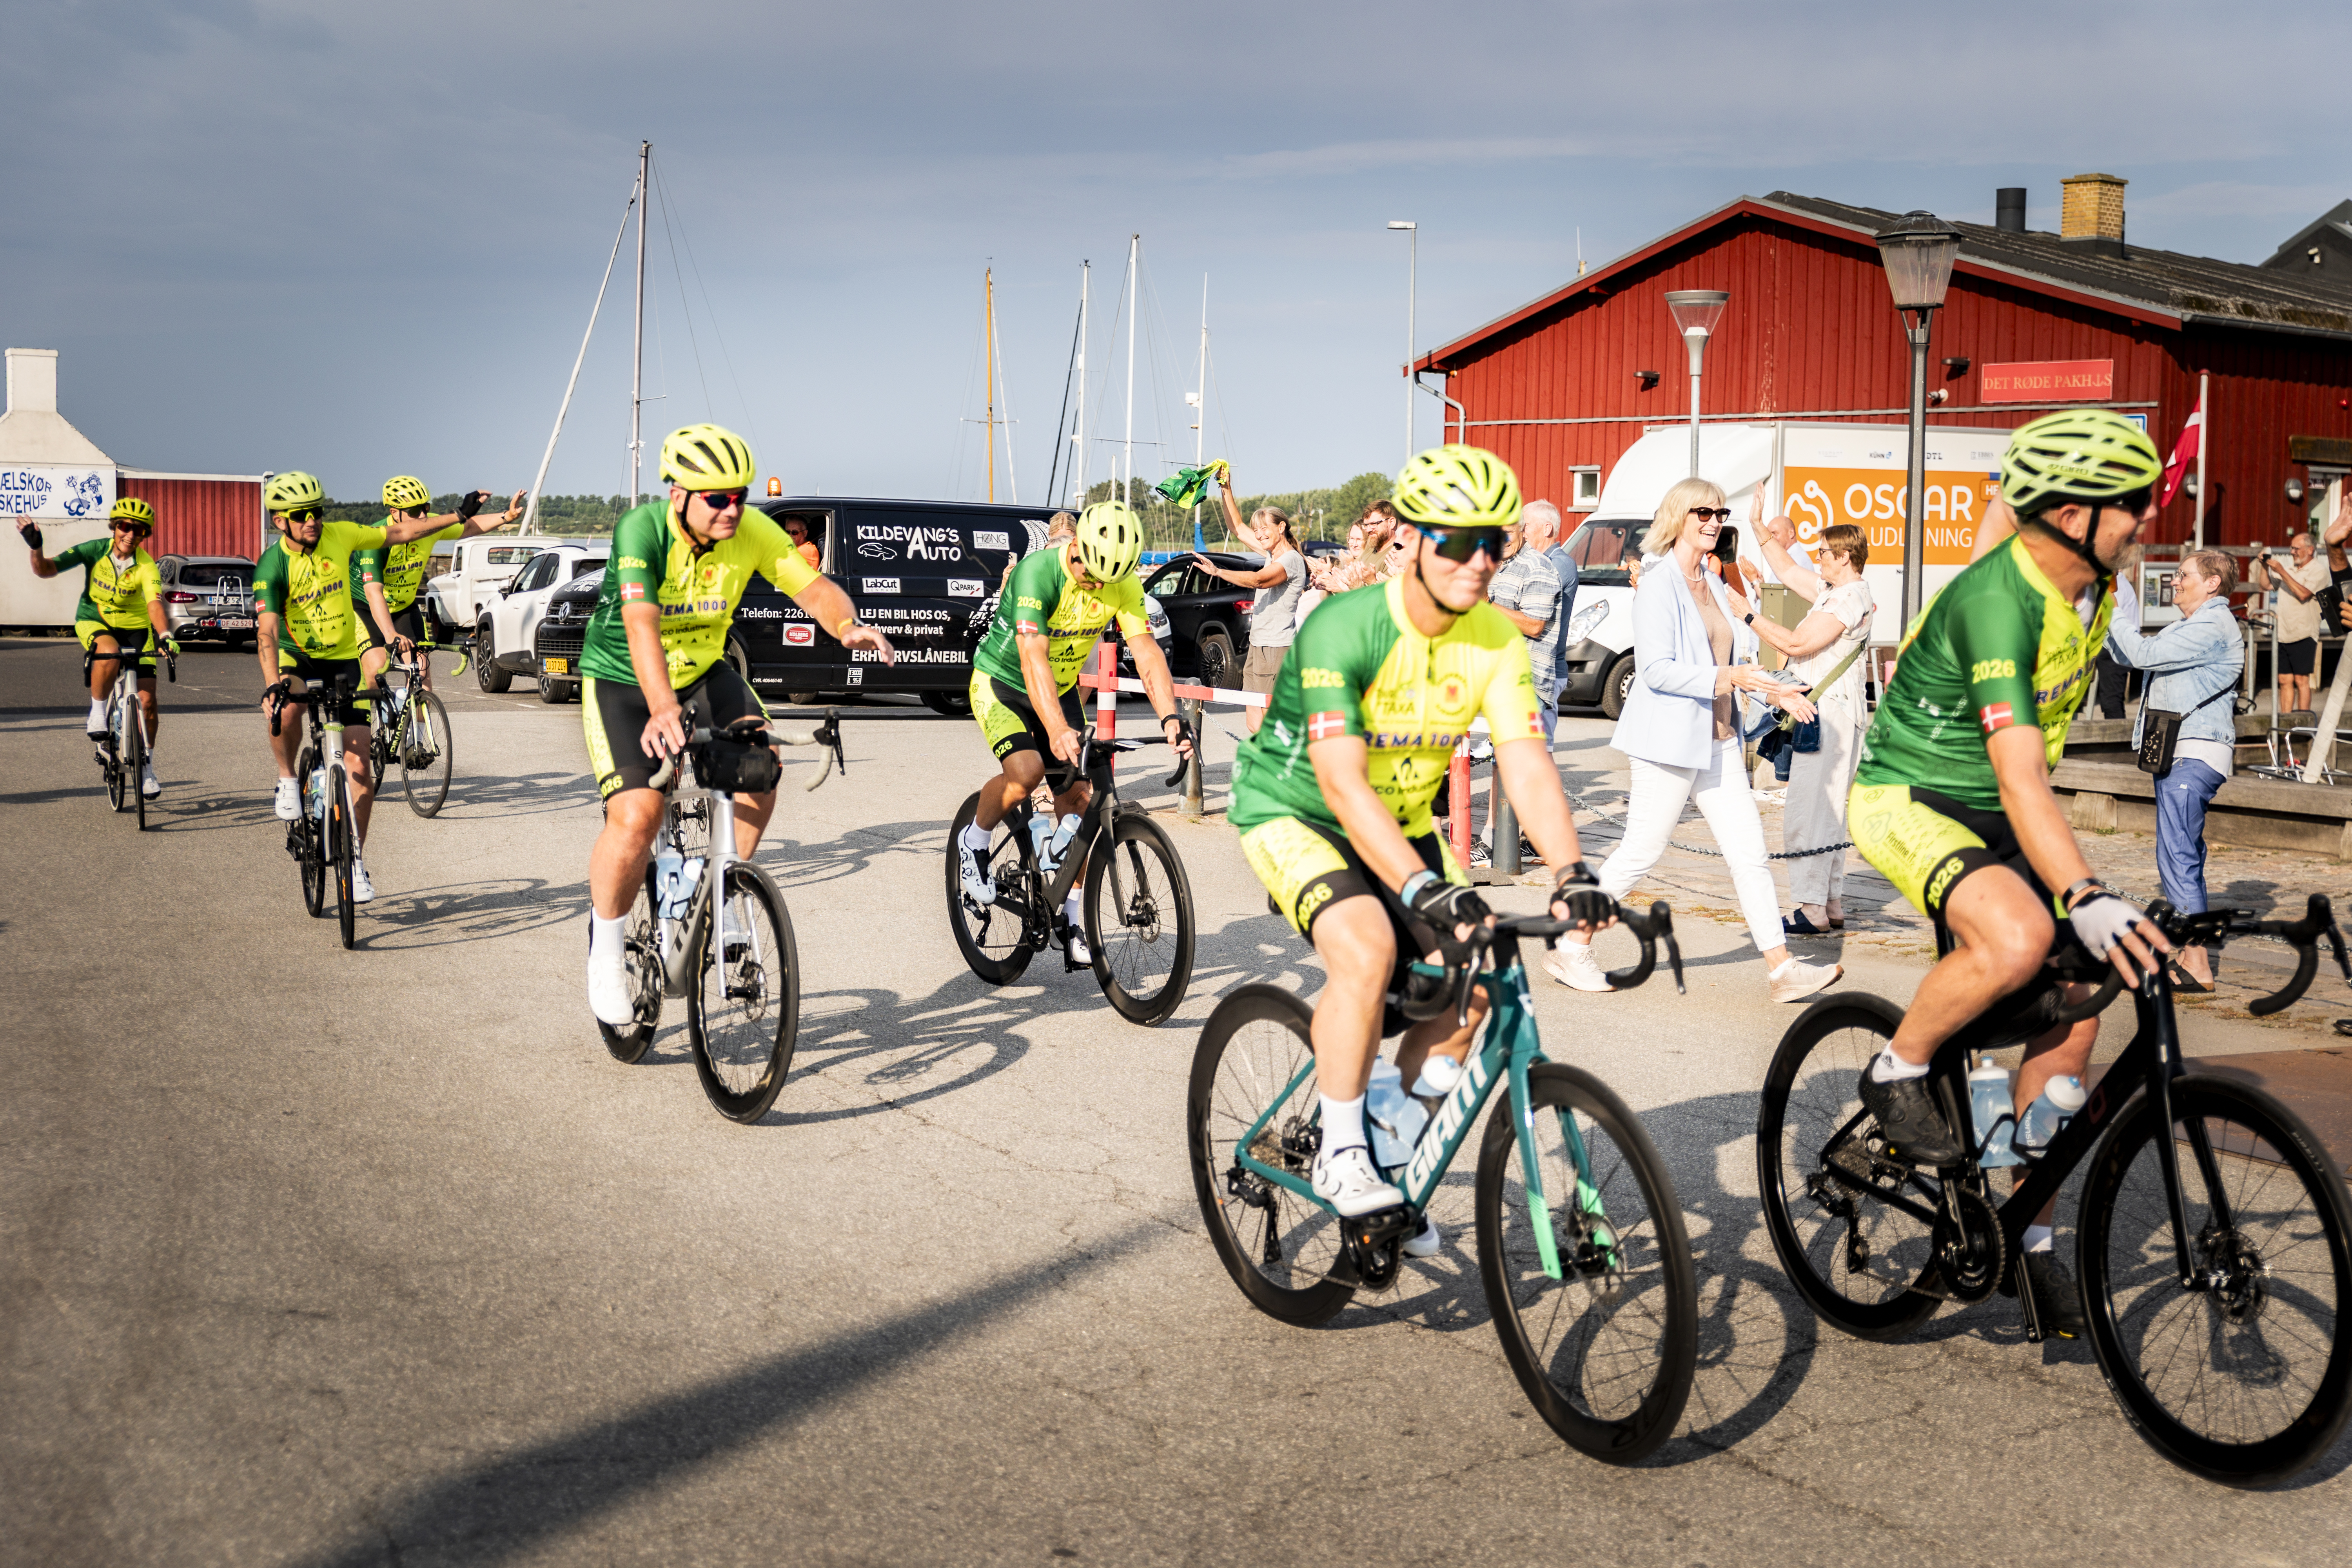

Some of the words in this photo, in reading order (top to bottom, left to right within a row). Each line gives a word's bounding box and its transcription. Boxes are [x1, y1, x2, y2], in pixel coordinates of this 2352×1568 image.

[1984, 377, 2010, 390] DET
[2013, 375, 2051, 389] RØDE
[907, 526, 961, 561] AUTO
[976, 533, 1006, 544] HØNG
[385, 564, 406, 574] REMA
[618, 555, 647, 570] 2026
[252, 580, 267, 592] 026
[323, 579, 343, 595] 1000
[670, 584, 686, 595] TAXA
[865, 579, 897, 589] LabCut
[697, 599, 727, 612] 1000
[1017, 596, 1042, 610] 2026
[316, 613, 345, 624] Industries
[741, 608, 782, 618] Telefon:
[860, 608, 877, 619] LEJ
[878, 609, 892, 619] EN
[894, 609, 909, 619] BIL
[911, 610, 932, 620] HOS
[934, 610, 951, 621] OS,
[675, 624, 710, 634] Industries
[905, 624, 913, 634] &
[914, 624, 943, 637] privat
[1048, 626, 1079, 638] REMA
[852, 647, 969, 663] ERHVRVSLÅNEBIL
[2053, 647, 2078, 671] TAXA
[552, 660, 557, 670] 37
[1972, 658, 2016, 684] 2026
[2034, 667, 2084, 705] REMA
[1383, 702, 1415, 715] TAXA
[1364, 731, 1423, 748] REMA
[1429, 734, 1463, 747] 100
[601, 775, 624, 799] 026
[1886, 831, 1909, 858] Firstline
[1927, 856, 1965, 910] 2026
[1405, 1054, 1488, 1202] GIANT
